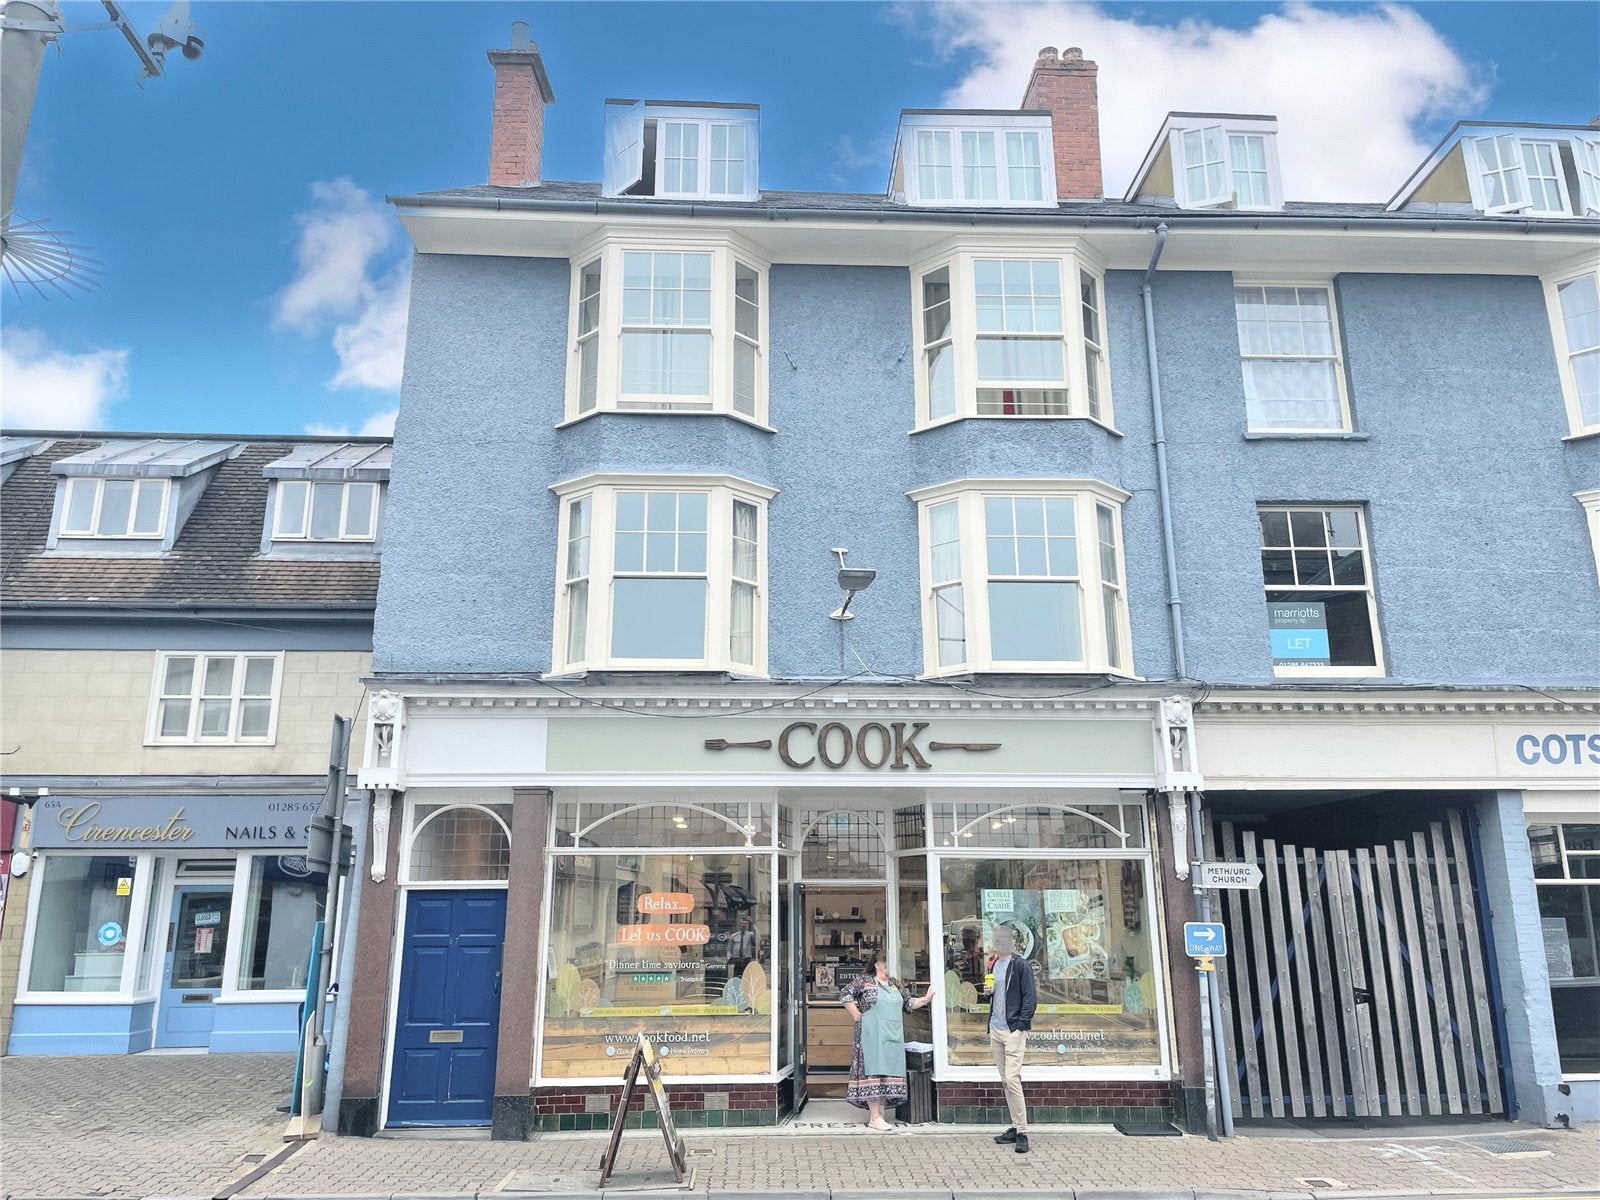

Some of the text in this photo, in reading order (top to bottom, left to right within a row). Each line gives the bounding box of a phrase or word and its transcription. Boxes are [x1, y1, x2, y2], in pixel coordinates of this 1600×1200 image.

[1274, 608, 1319, 618] marriotts
[1287, 638, 1311, 649] LET
[777, 721, 933, 770] COOK
[1515, 733, 1600, 766] COTS
[44, 800, 62, 809] 65A
[268, 802, 300, 812] 01285
[57, 801, 196, 842] Cirencester
[225, 825, 278, 840] NAILS
[284, 825, 296, 840] &
[1207, 867, 1251, 876] METH/URC
[1212, 875, 1248, 884] CHURCH
[644, 896, 688, 910] Relax...
[622, 927, 707, 942] Let us COOK
[1189, 944, 1204, 952] ONE
[642, 959, 661, 969] time
[604, 1030, 711, 1043] www.ookfood.net
